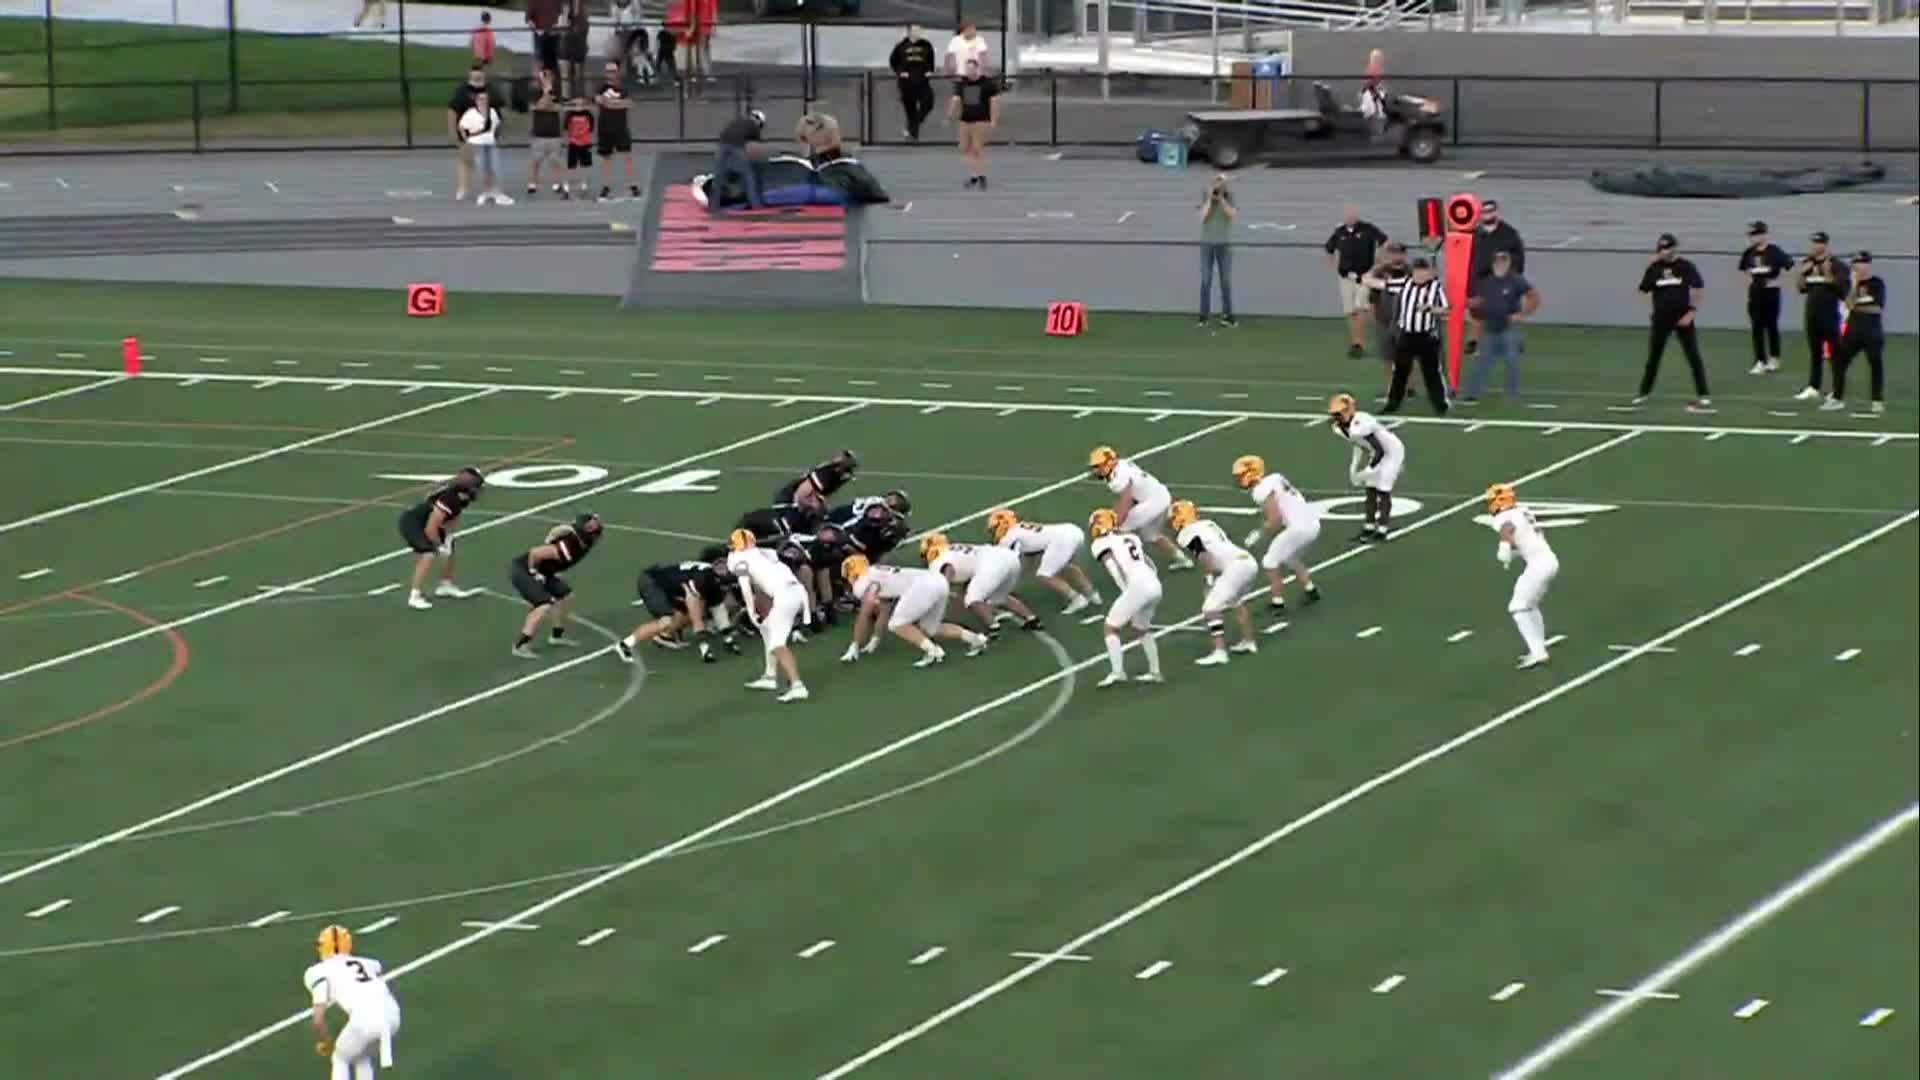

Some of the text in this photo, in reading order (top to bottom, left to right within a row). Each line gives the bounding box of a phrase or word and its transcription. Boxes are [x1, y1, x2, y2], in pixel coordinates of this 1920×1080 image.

[412, 287, 437, 312] G
[1052, 305, 1075, 331] 10
[1123, 537, 1140, 561] 2
[345, 960, 373, 983] 3
